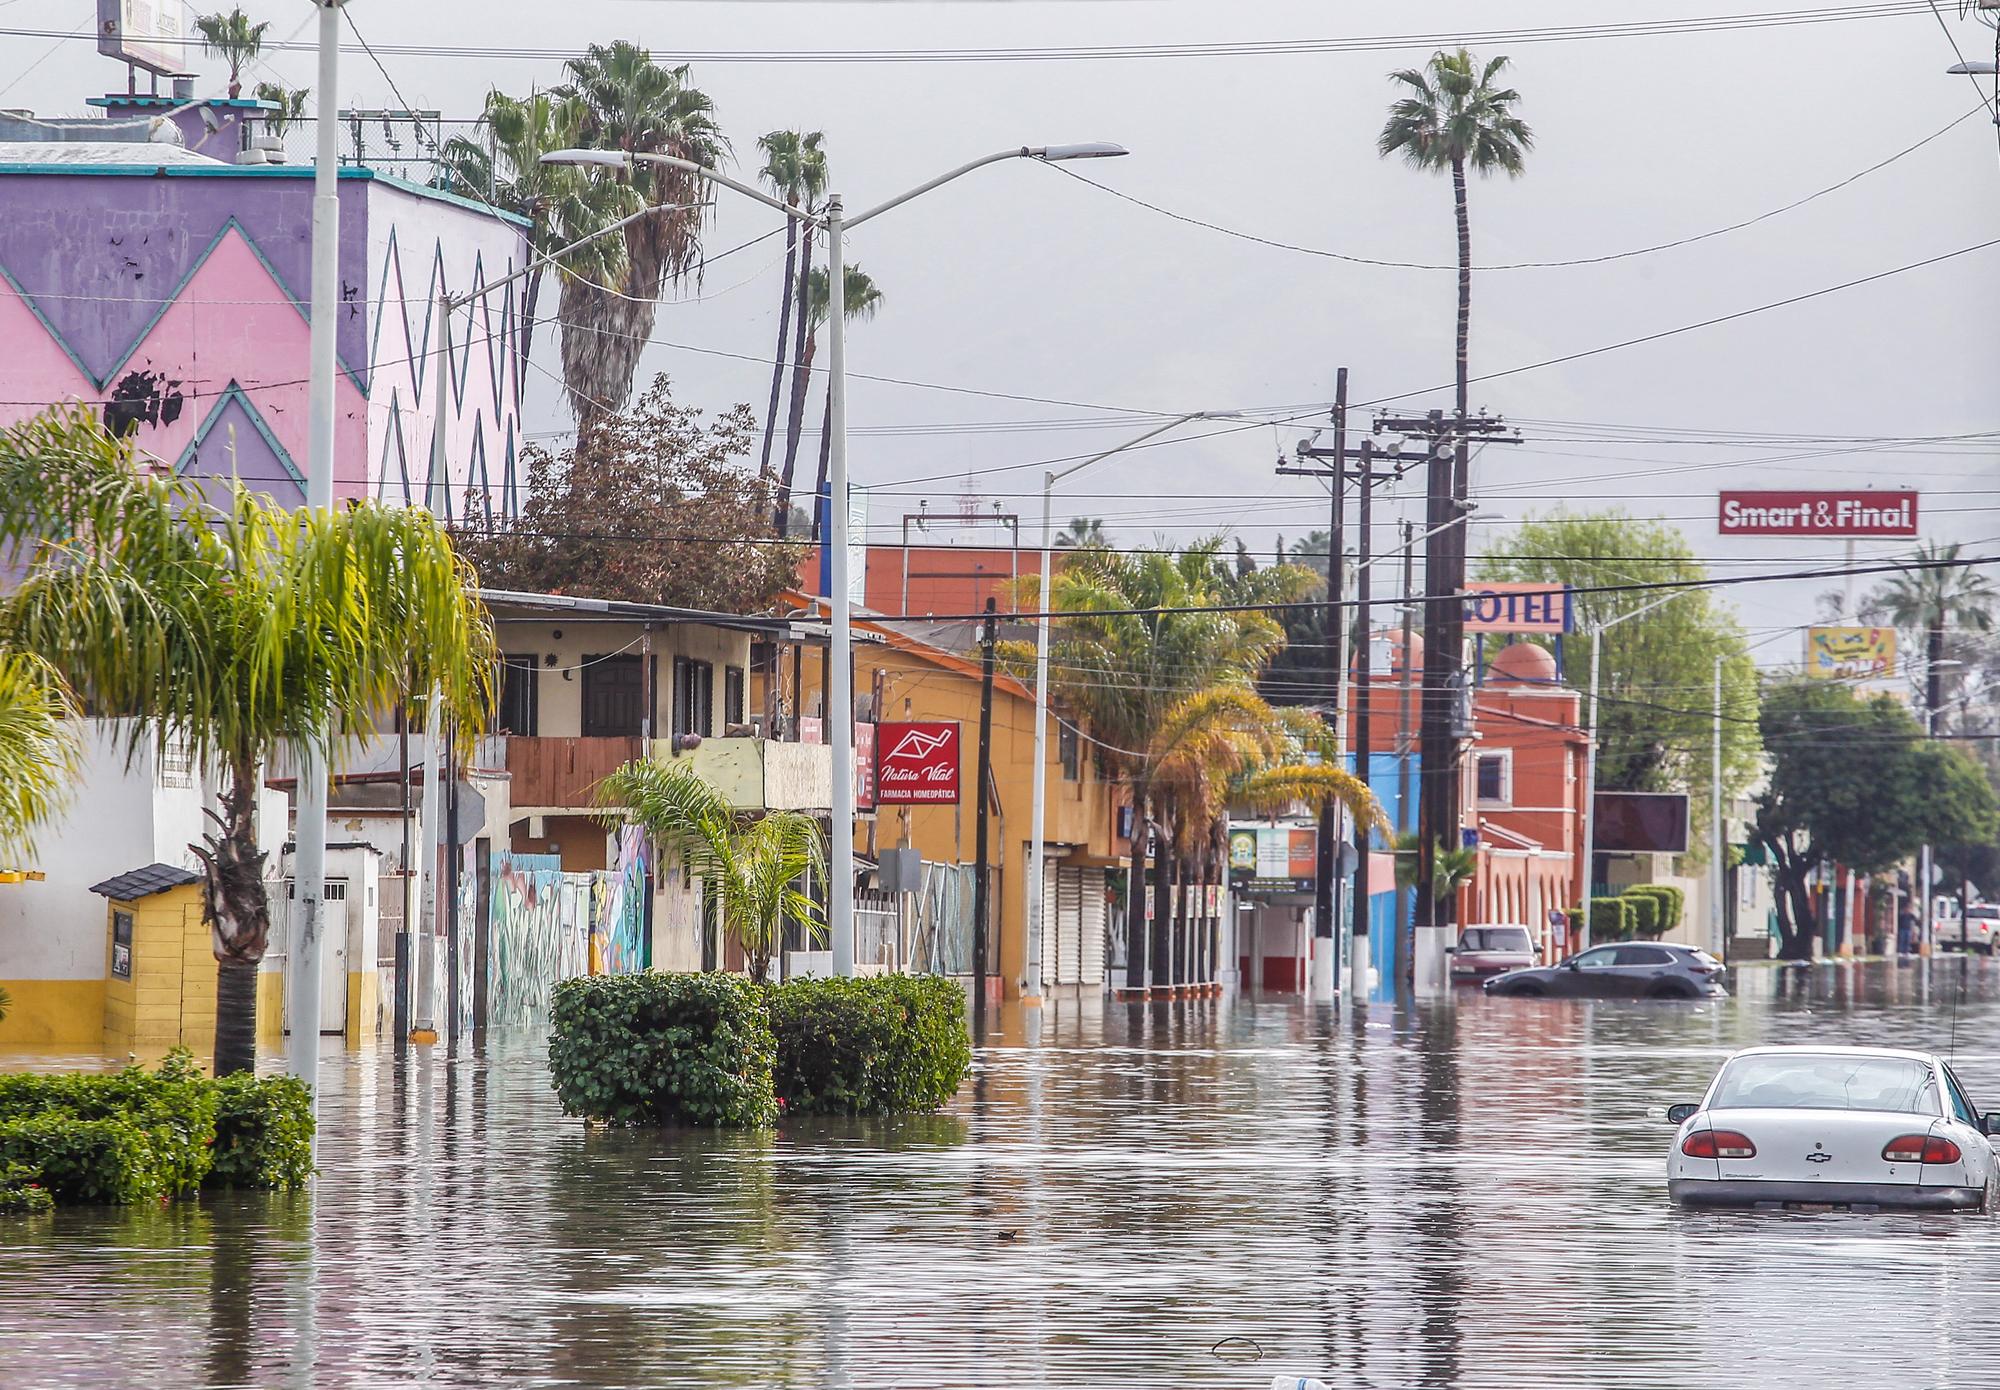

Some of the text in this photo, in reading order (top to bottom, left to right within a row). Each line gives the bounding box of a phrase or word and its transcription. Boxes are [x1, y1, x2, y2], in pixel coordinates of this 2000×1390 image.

[1463, 590, 1560, 623] OTEL
[881, 765, 920, 782] Natura
[921, 761, 955, 782] Vital
[880, 788, 955, 799] FARMACIA HOMEOPÁTICA
